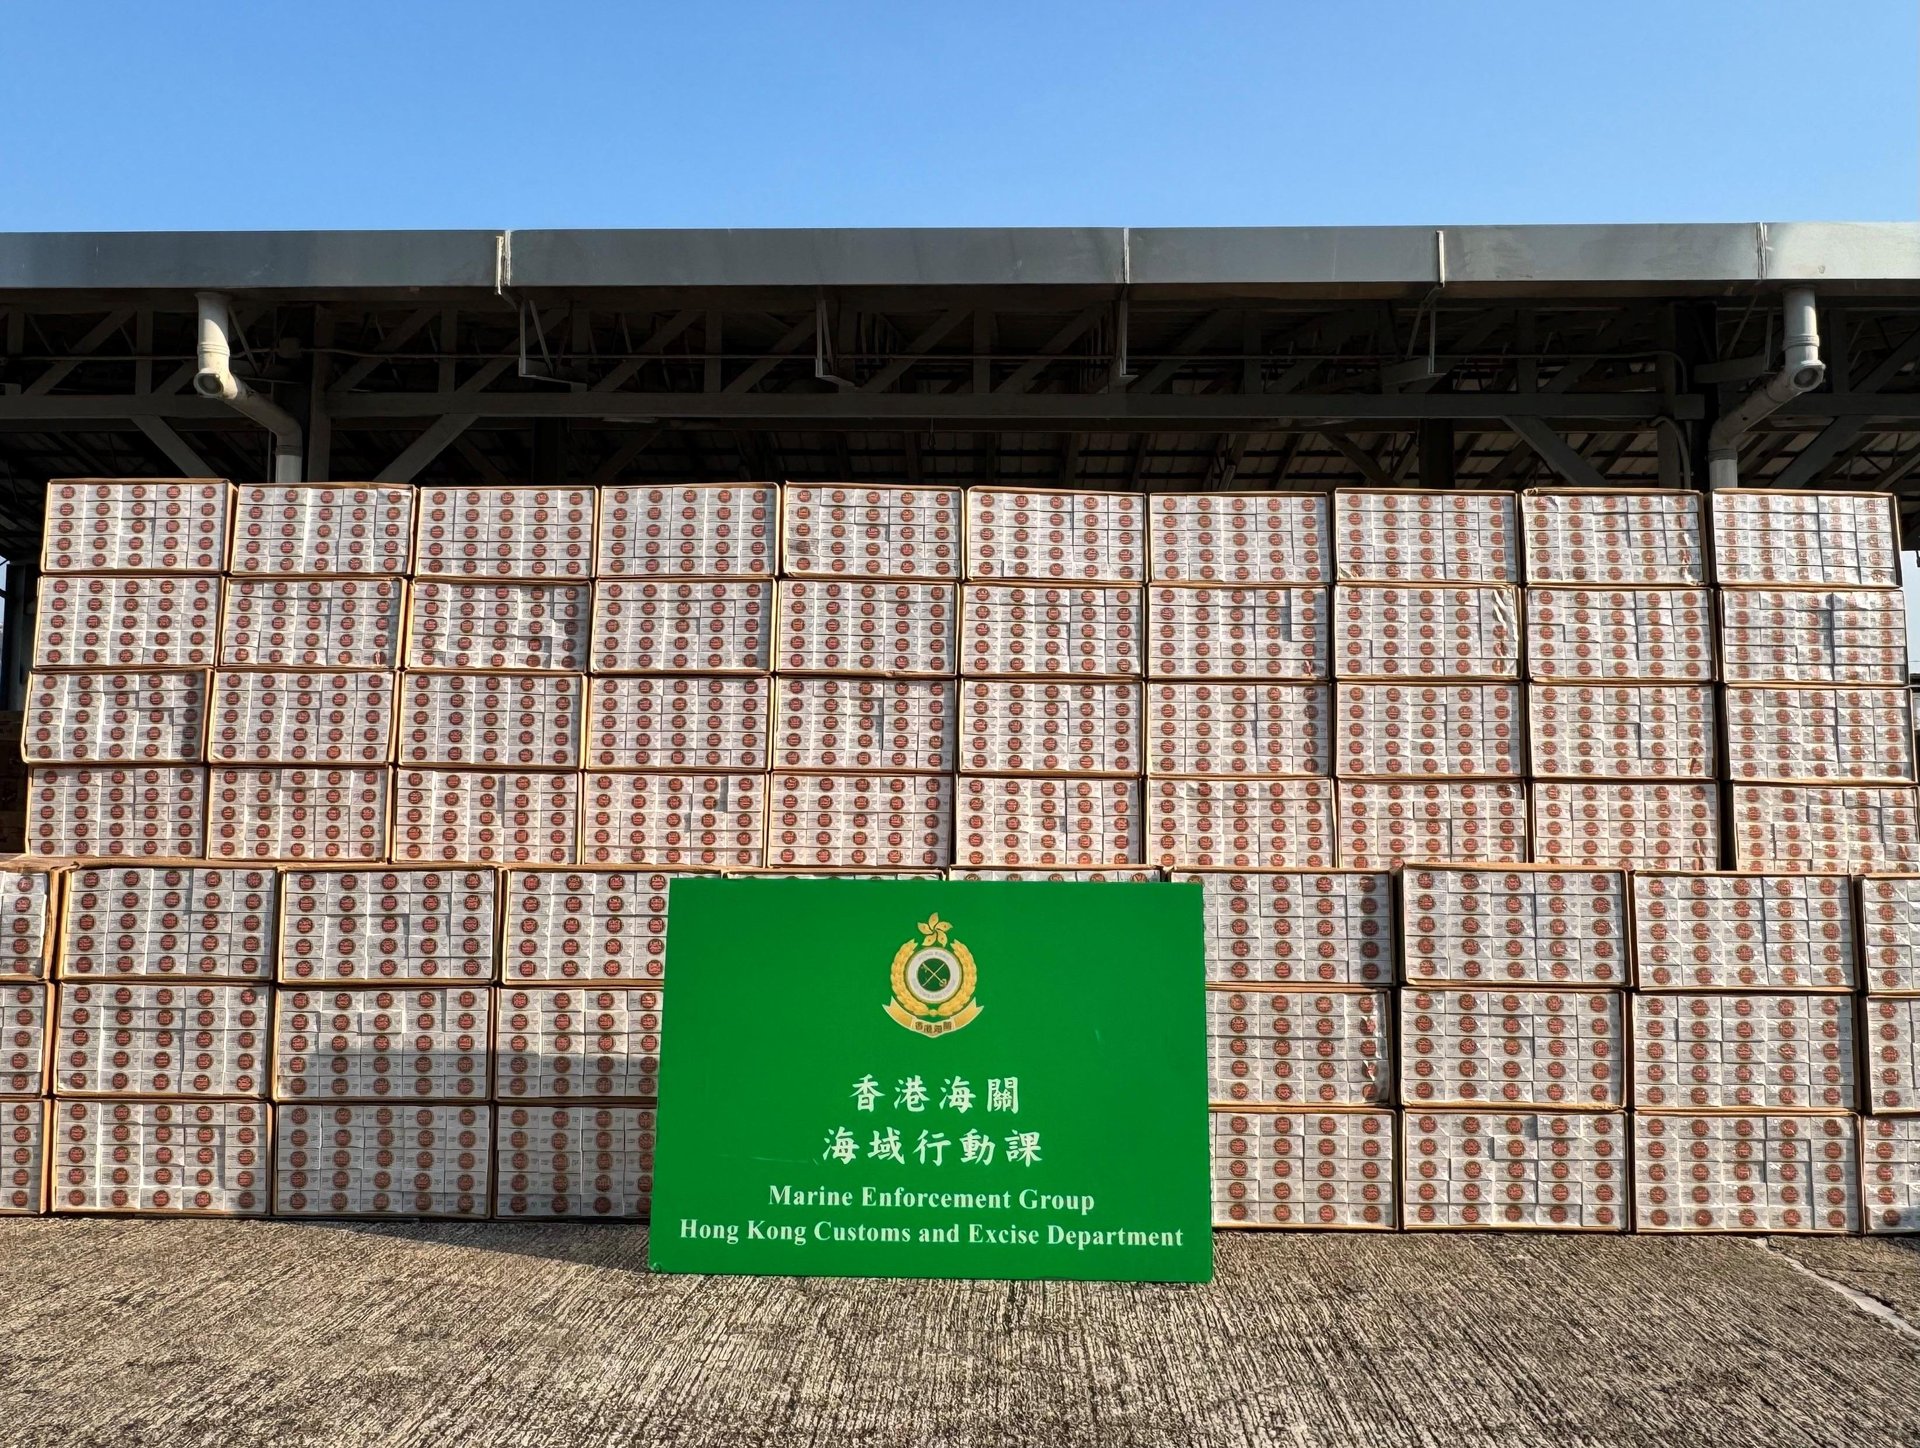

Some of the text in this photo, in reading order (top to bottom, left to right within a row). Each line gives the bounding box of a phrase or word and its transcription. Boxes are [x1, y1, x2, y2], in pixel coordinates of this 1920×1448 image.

[850, 1073, 1020, 1114] 香港海關
[822, 1126, 1042, 1168] 海域行動課
[769, 1185, 1095, 1216] Marine Enforcement Group
[680, 1218, 1184, 1251] Hong Kong Customs and Excise Department
